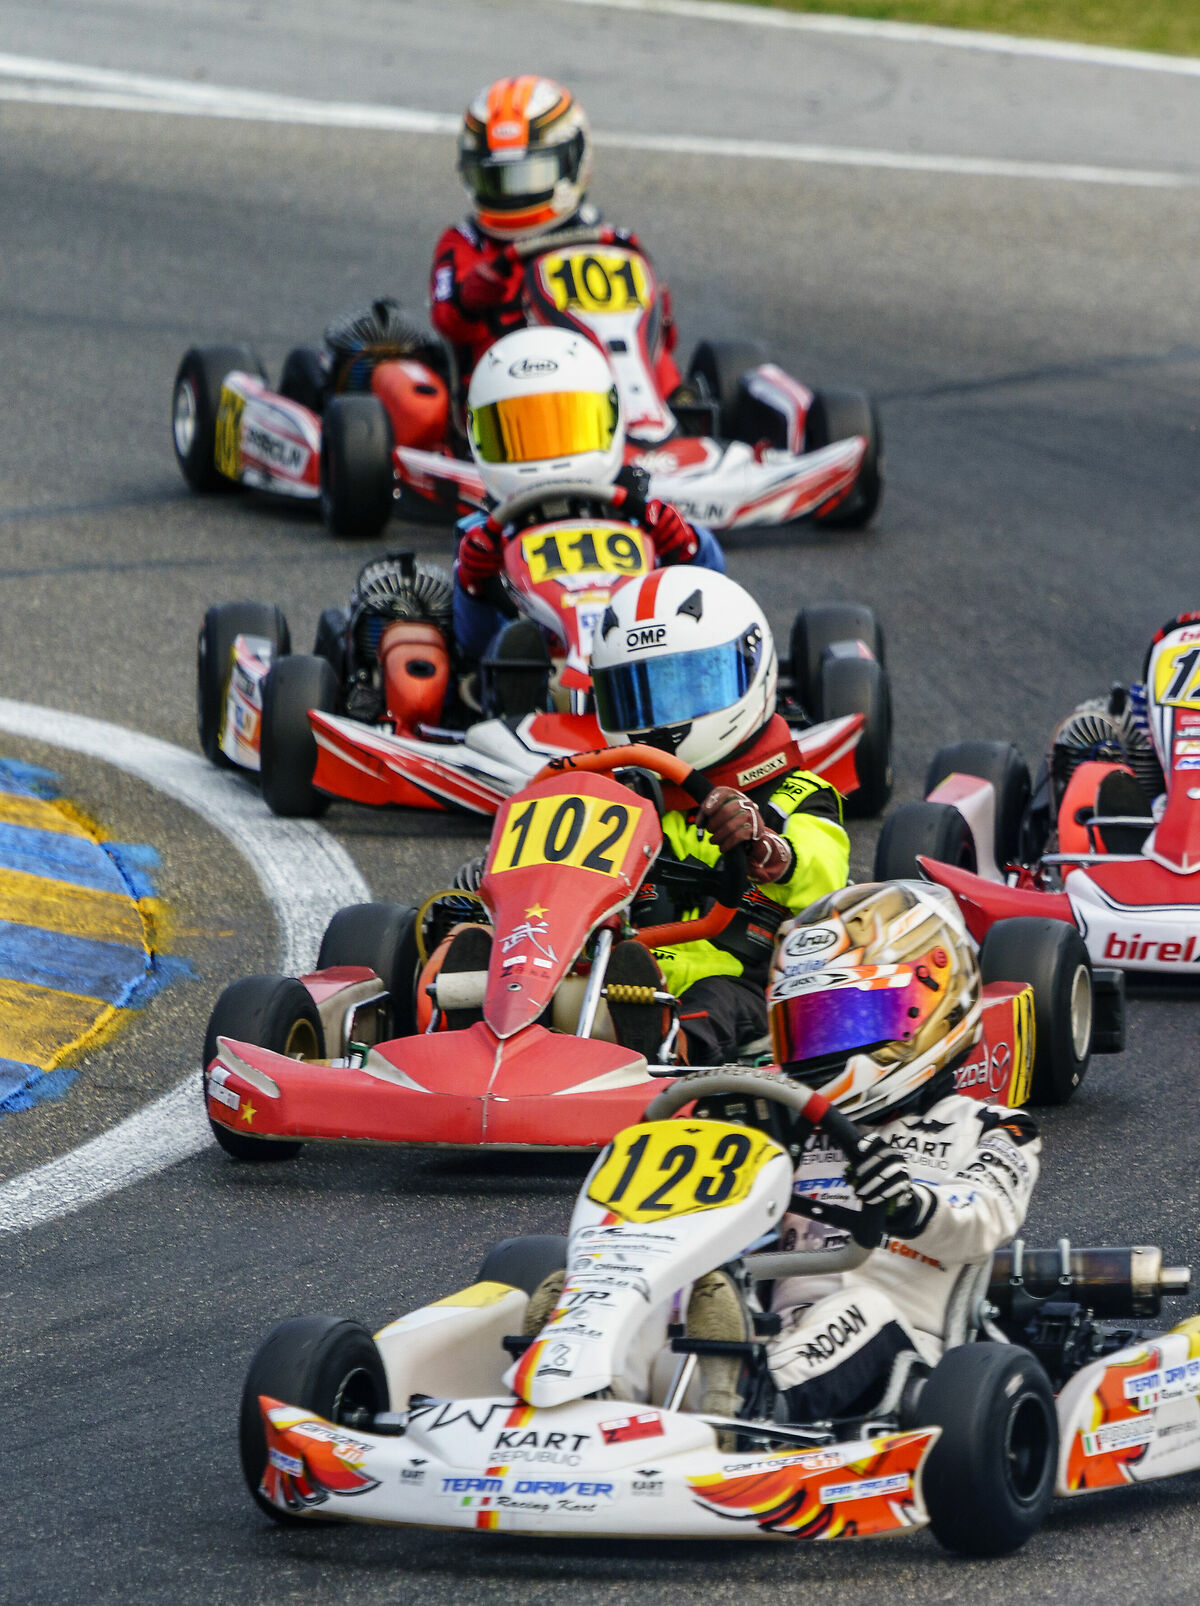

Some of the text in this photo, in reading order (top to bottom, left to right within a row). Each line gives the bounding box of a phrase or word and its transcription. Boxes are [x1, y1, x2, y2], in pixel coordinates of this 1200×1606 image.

[552, 256, 638, 302] 101
[532, 533, 643, 571] 119
[626, 628, 667, 647] OMP
[741, 756, 785, 784] ARROXX
[507, 796, 629, 874] 102
[794, 931, 832, 950] Arai
[890, 1133, 953, 1158] KART
[608, 1133, 752, 1212] 123
[904, 1151, 949, 1171] PUBLIC
[495, 1431, 591, 1451] KART
[488, 1451, 583, 1467] REPUBLIC
[442, 1477, 614, 1500] TEAM DRIVER
[496, 1496, 597, 1513] Racing Kart
